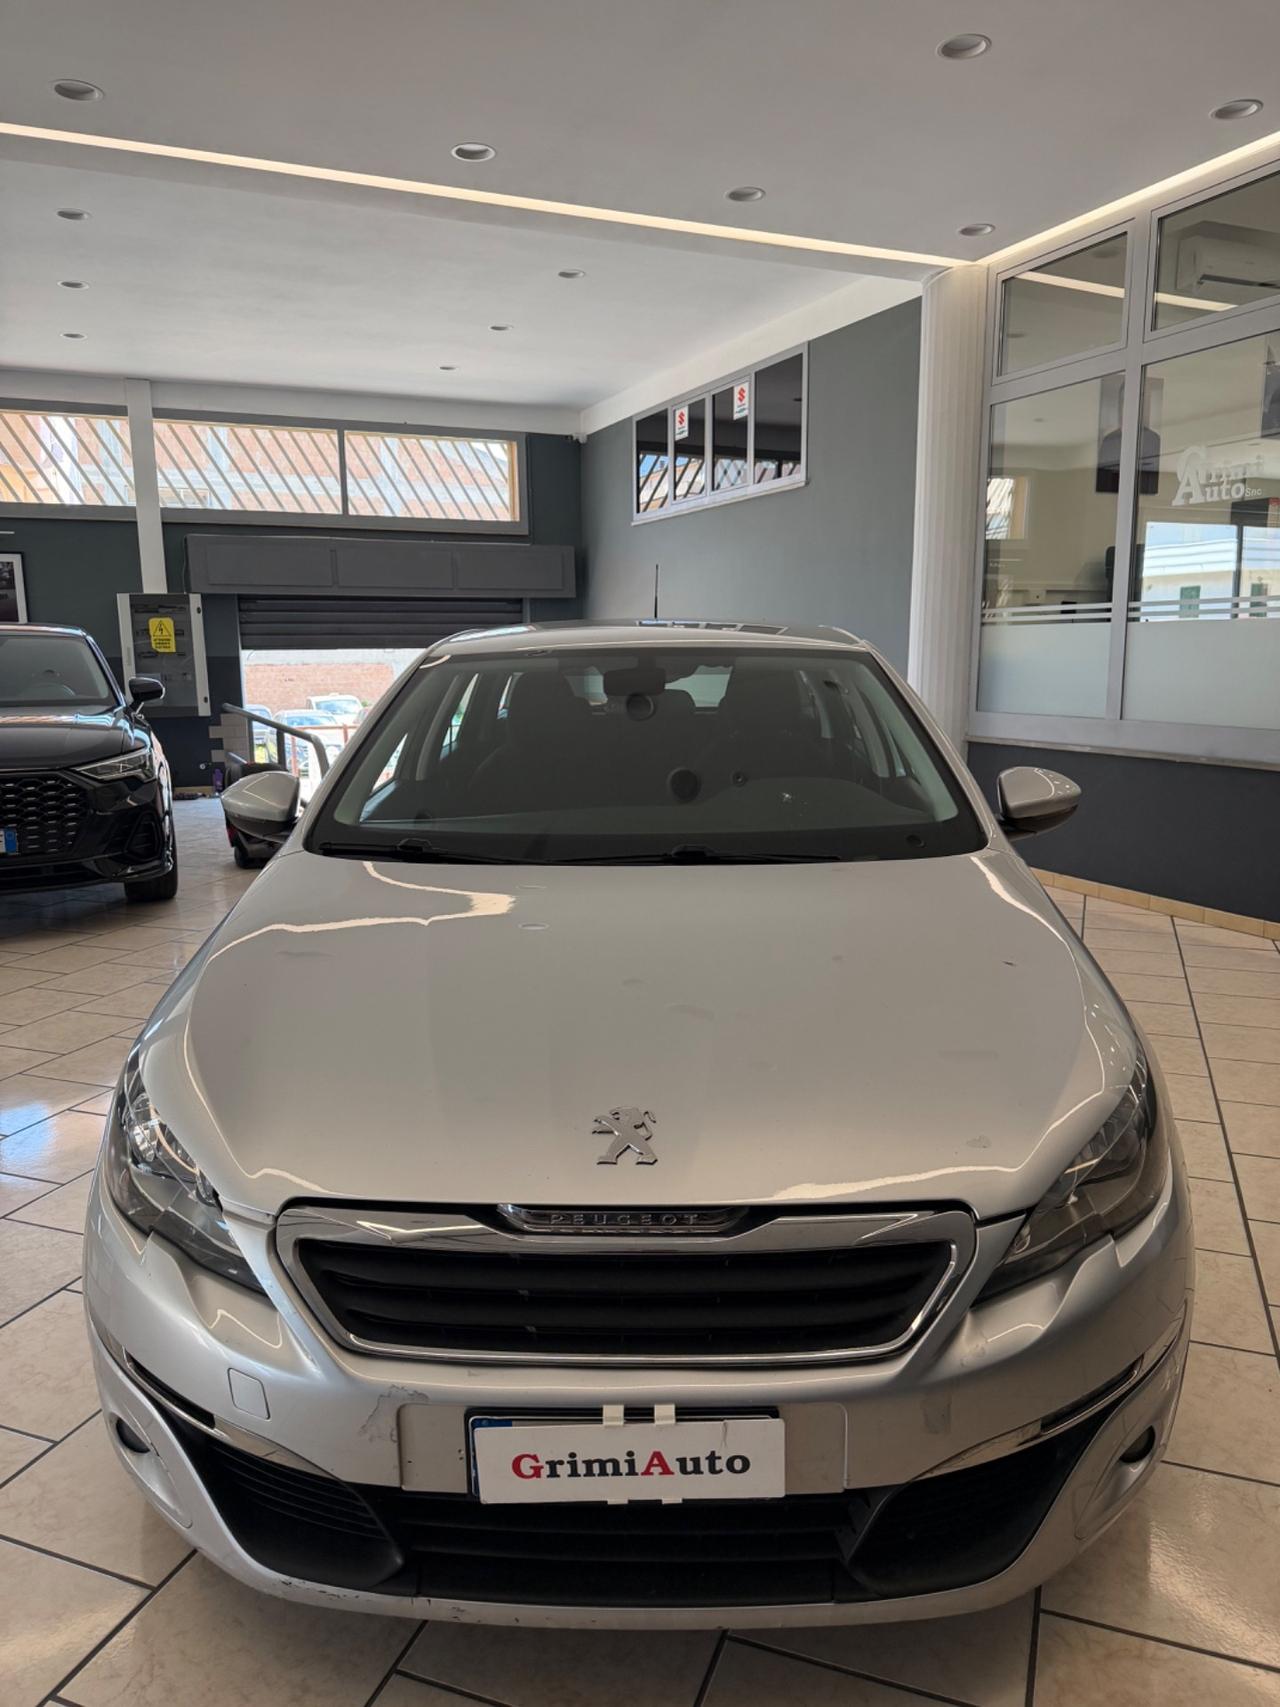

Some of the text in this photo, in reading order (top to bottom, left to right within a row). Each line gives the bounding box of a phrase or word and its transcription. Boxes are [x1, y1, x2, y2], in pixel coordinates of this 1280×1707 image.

[1171, 461, 1245, 506] Auto
[550, 1213, 699, 1225] PEUGEOT
[511, 1450, 751, 1479] GrimiAuto
